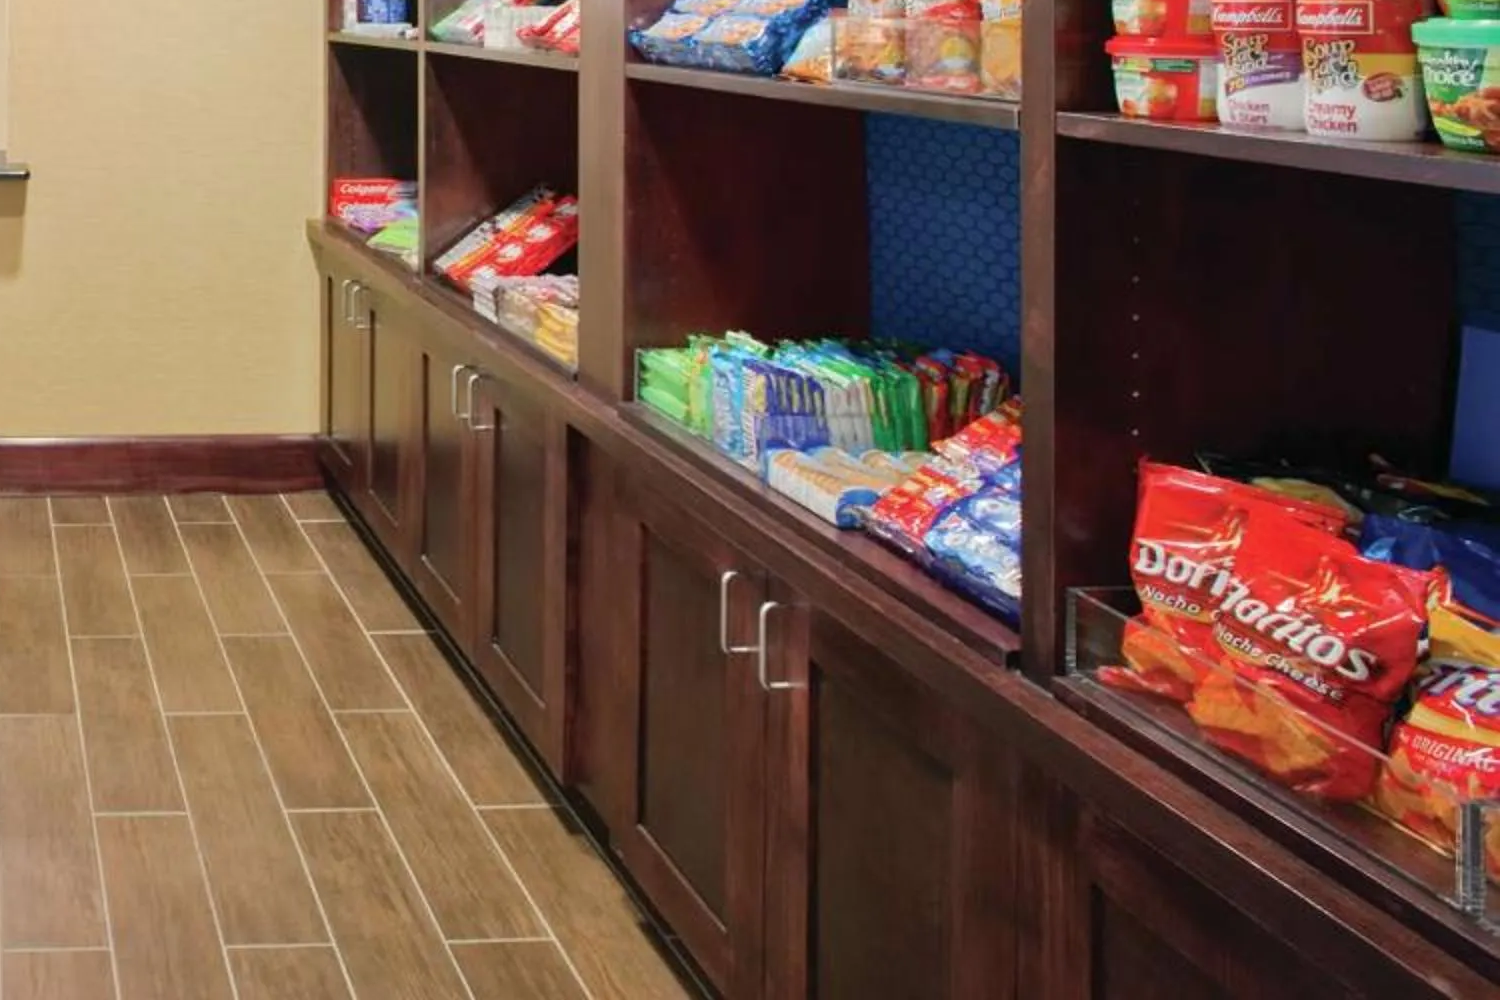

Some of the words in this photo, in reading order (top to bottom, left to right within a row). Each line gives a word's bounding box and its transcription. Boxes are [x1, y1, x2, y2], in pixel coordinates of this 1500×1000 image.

[1212, 4, 1284, 25] Campbell's
[1140, 585, 1201, 615] Nacho
[1214, 622, 1264, 659] Nacho
[1265, 652, 1345, 701] Cheese
